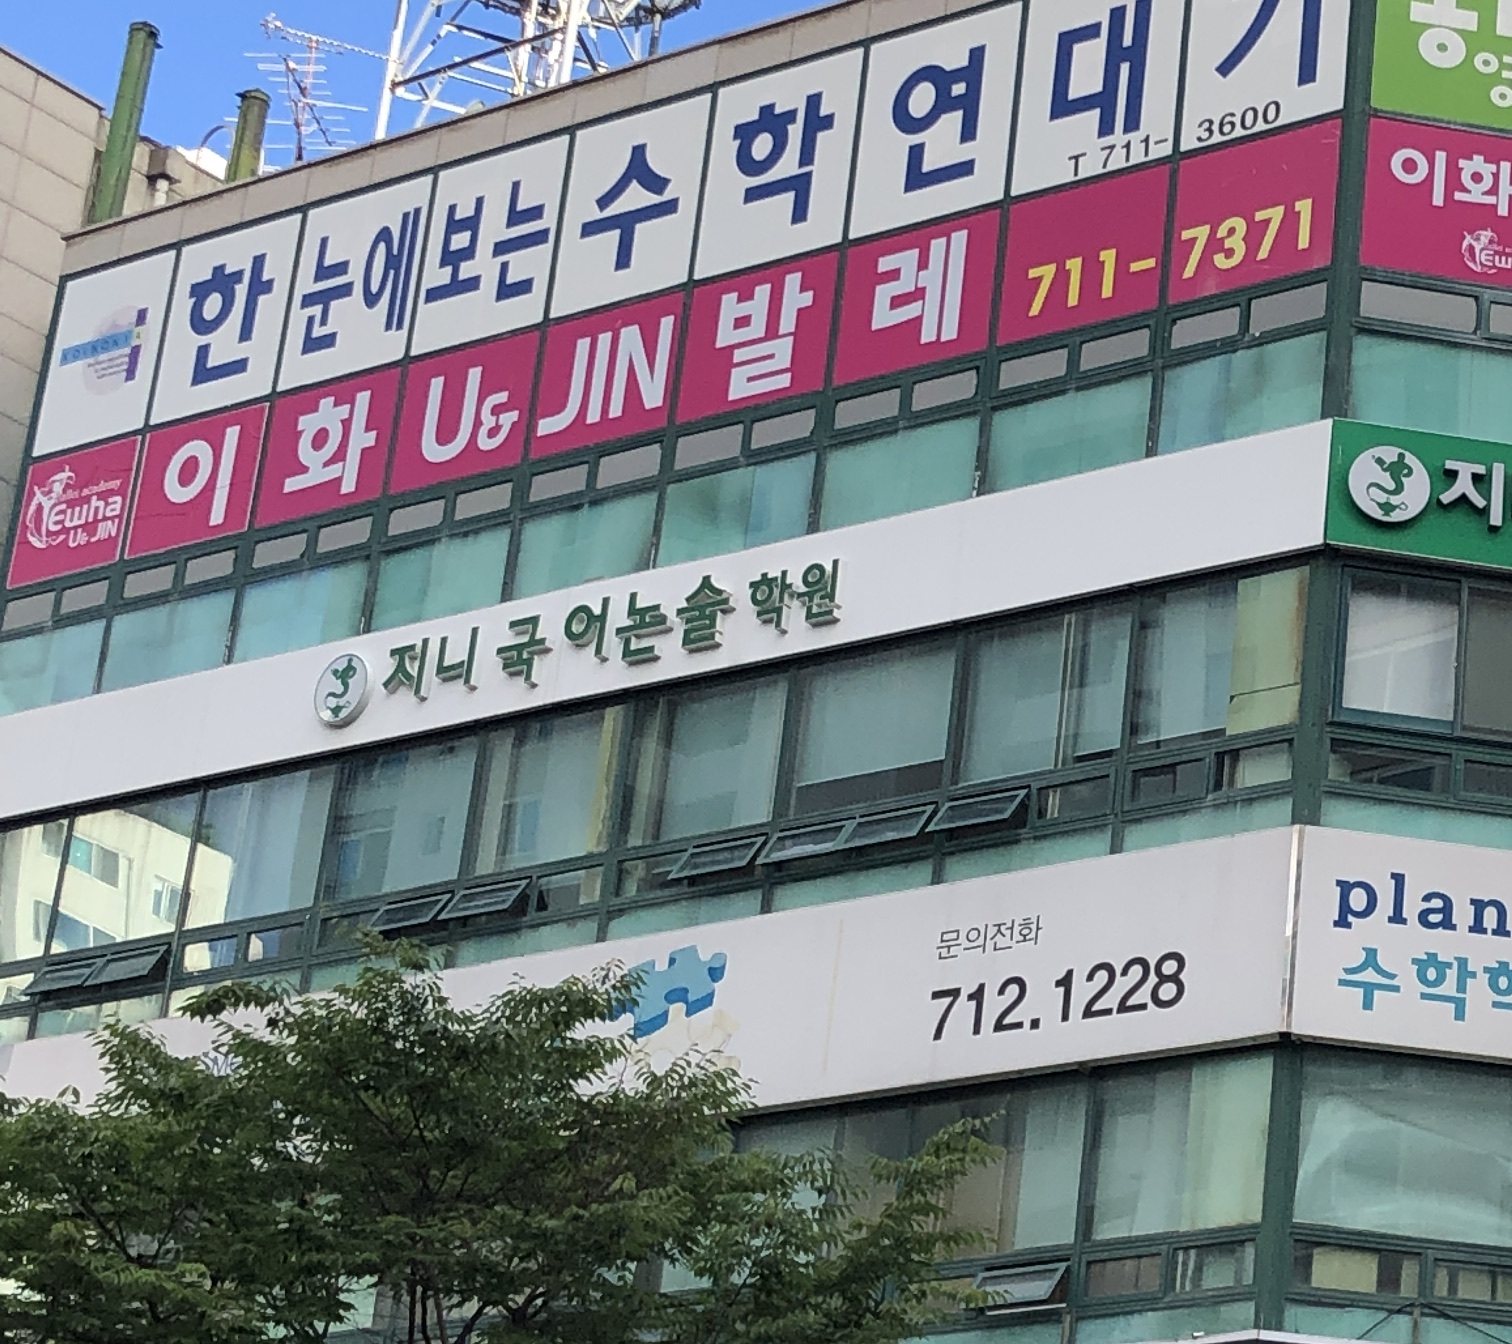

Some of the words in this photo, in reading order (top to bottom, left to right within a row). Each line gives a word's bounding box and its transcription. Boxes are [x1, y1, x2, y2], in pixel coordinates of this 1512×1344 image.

[1067, 152, 1088, 178] T
[162, 394, 381, 526] 이화
[538, 313, 680, 431] JIN
[715, 229, 968, 402] 발레
[1027, 197, 1314, 318] 711-7371
[48, 495, 122, 532] Ewha
[935, 914, 1043, 962] 문의전화
[930, 951, 1187, 1042] 712.1228
